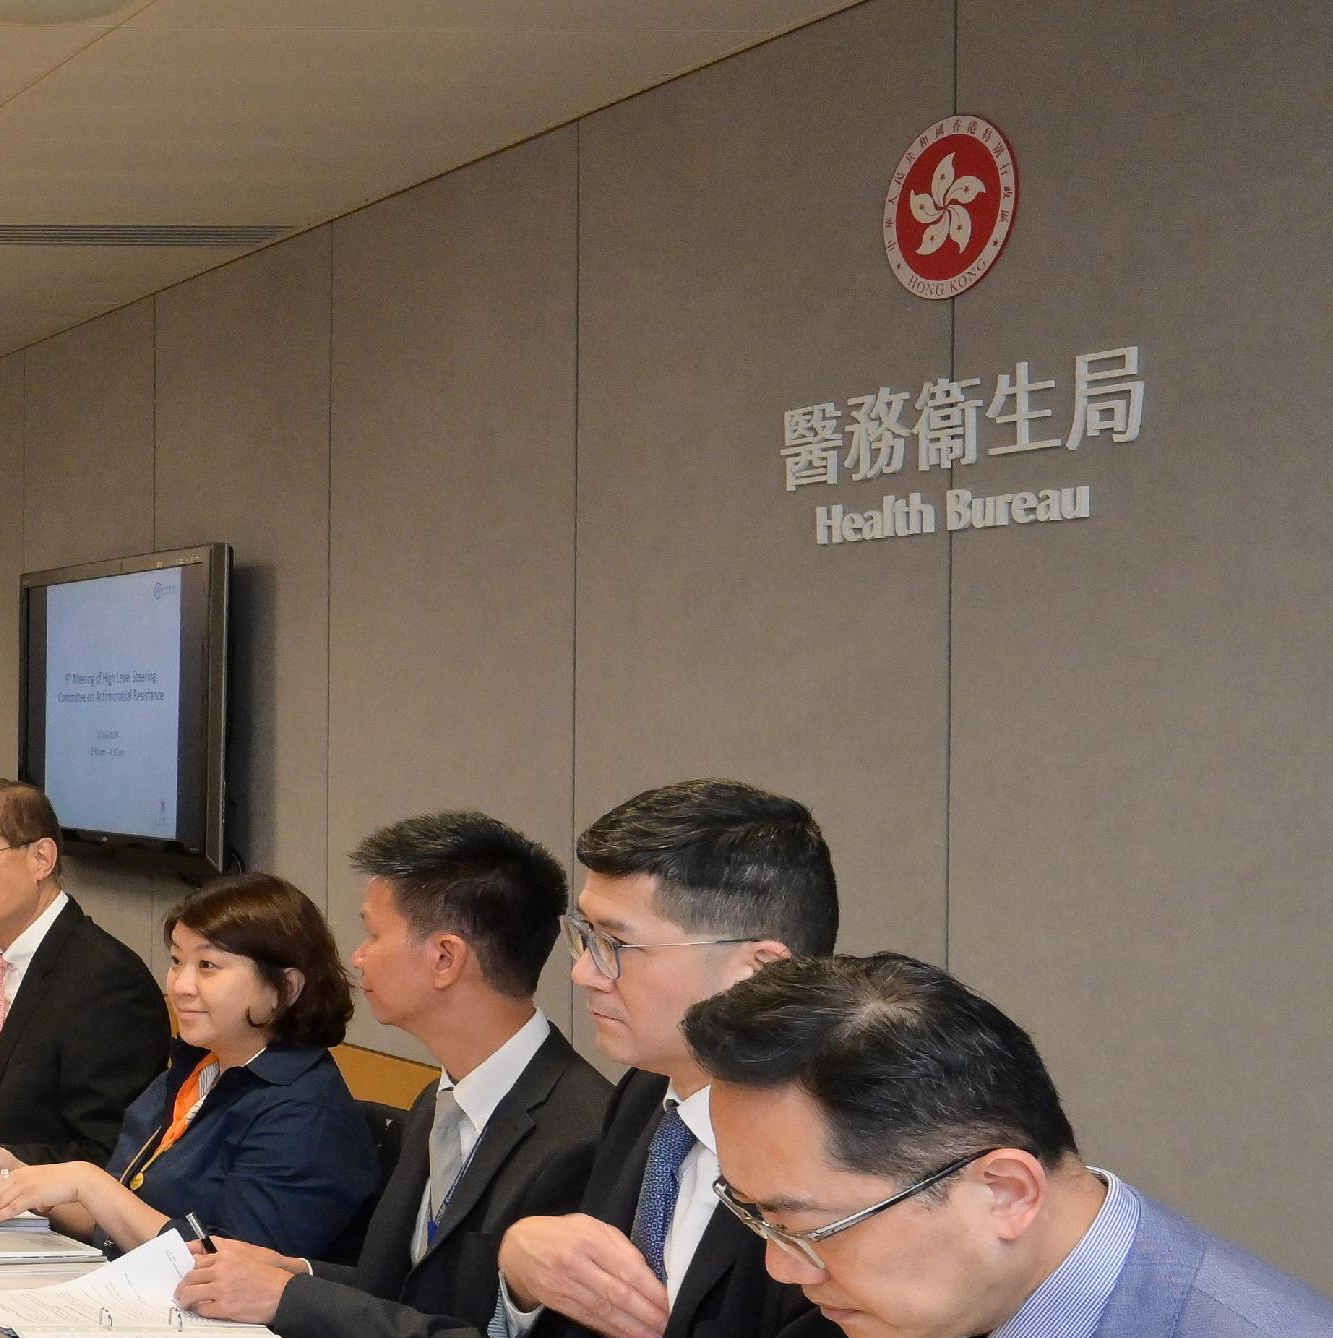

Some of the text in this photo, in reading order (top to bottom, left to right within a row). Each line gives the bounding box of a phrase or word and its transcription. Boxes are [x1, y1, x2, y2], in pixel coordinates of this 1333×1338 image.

[907, 260, 986, 297] HONG KONG
[815, 485, 1090, 545] Health Bureau
